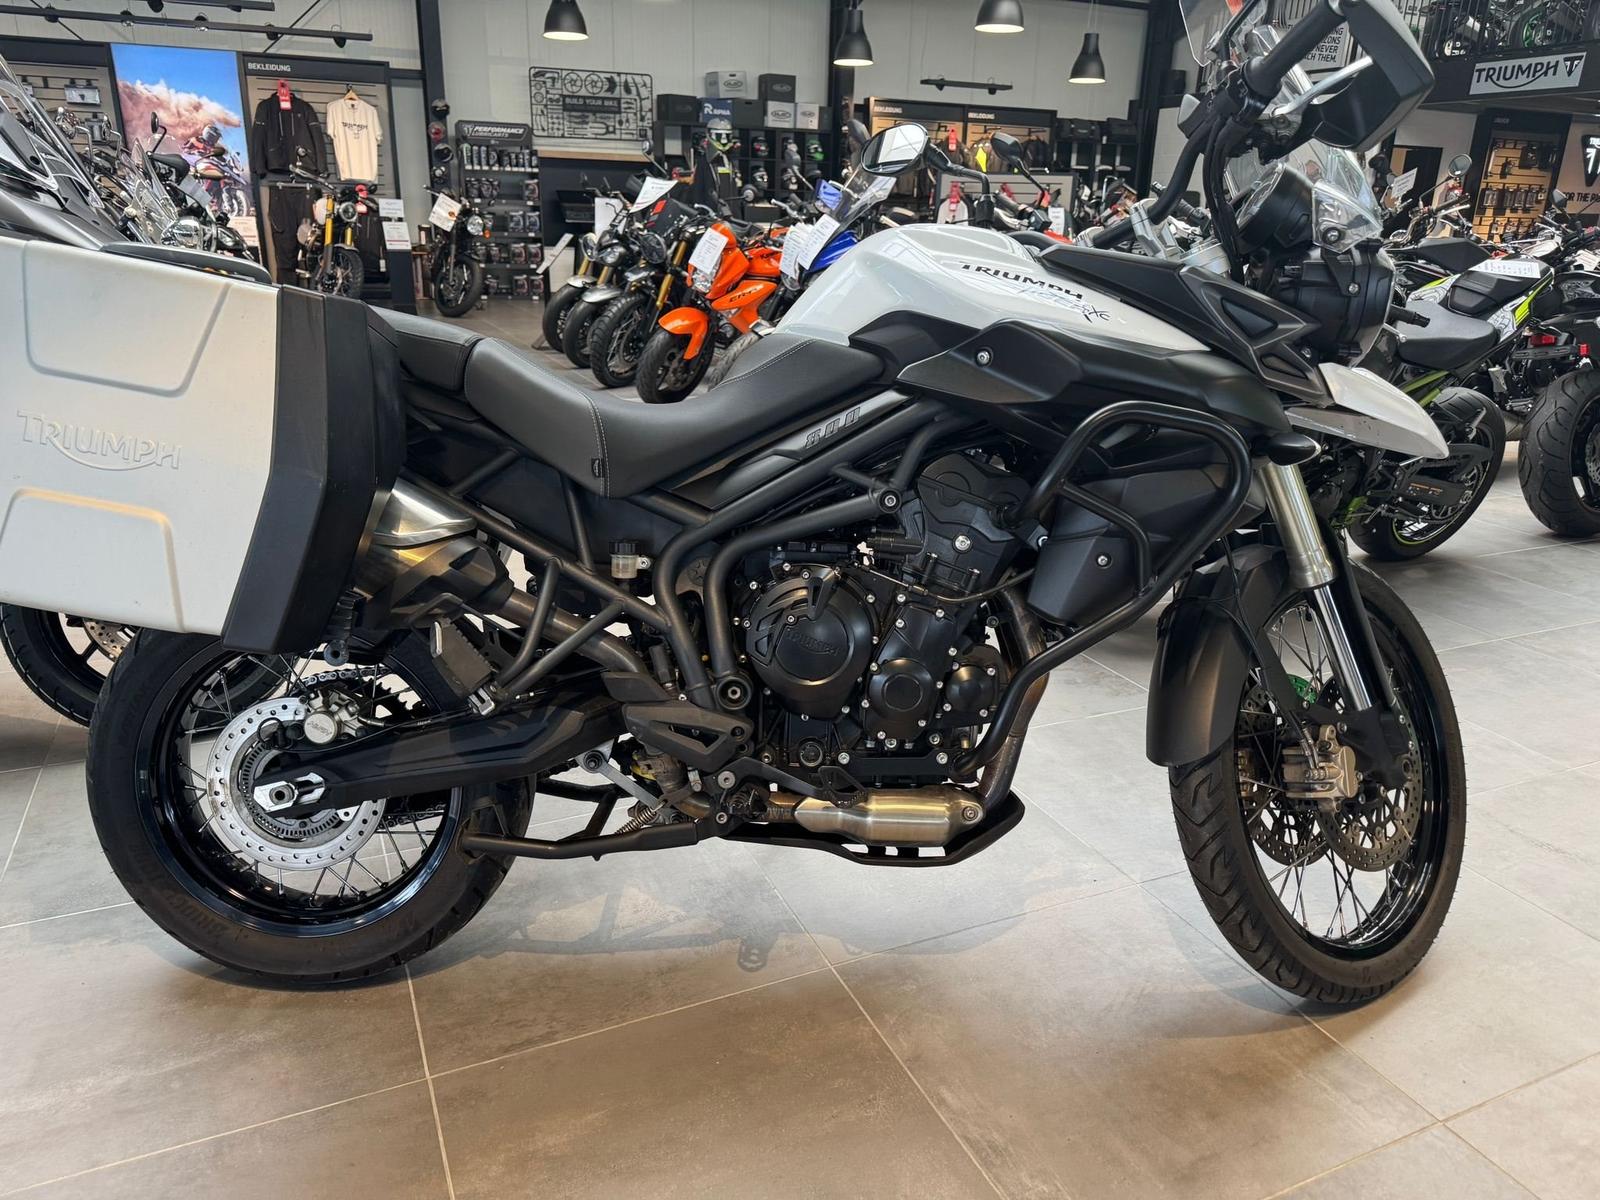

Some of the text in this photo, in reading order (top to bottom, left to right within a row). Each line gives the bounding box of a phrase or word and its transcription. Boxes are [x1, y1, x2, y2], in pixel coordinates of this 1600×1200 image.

[1315, 44, 1339, 54] NEVER
[247, 62, 291, 72] BEKLEIDUNG
[1475, 60, 1560, 88] TRIUMPH
[474, 126, 525, 135] PERFORMANCE
[1576, 192, 1591, 202] THE
[960, 261, 1083, 299] TRIUMPH
[804, 407, 861, 449] 800
[16, 409, 182, 471] TRIUMPH
